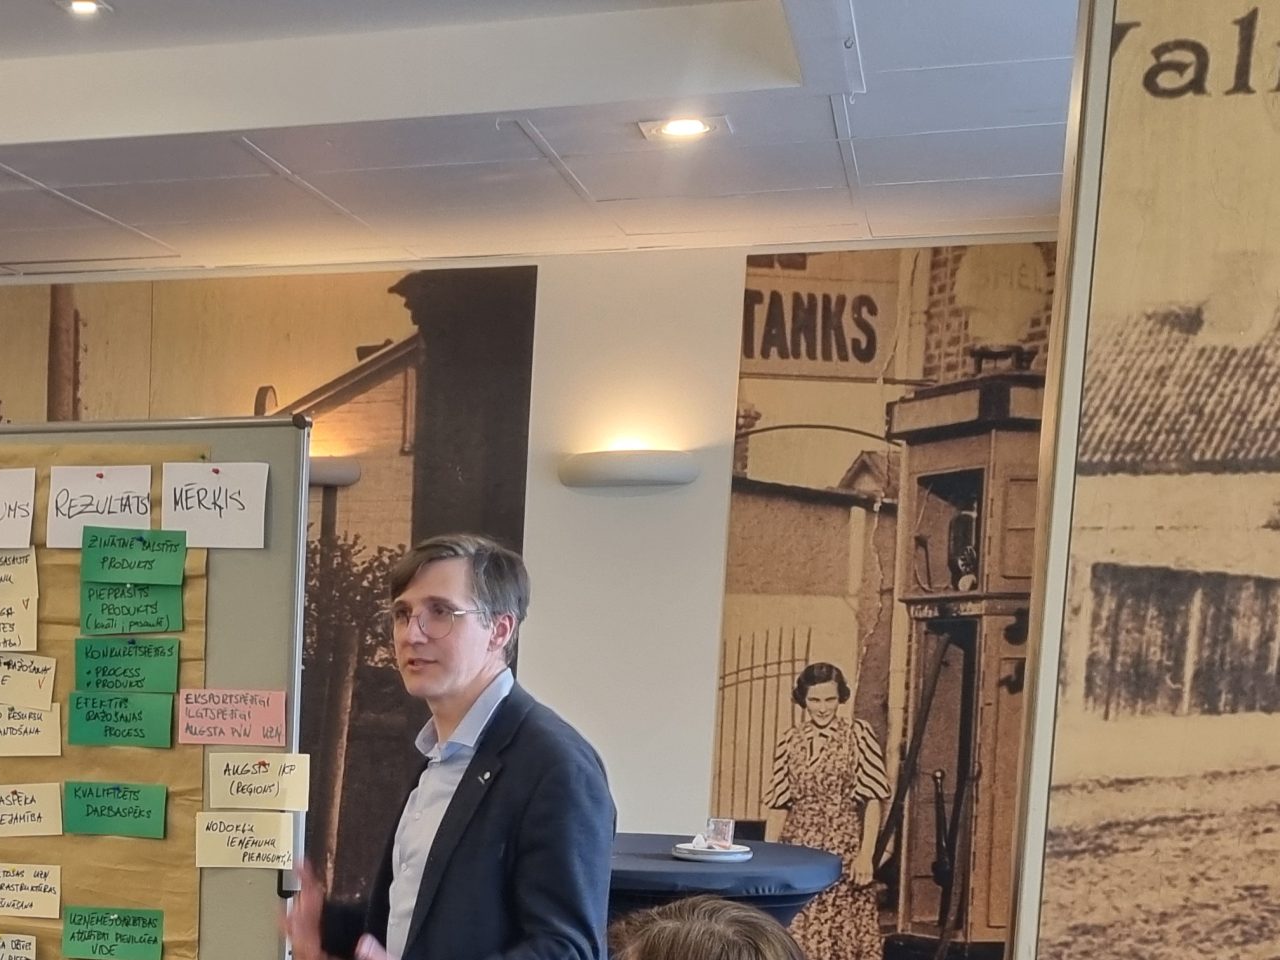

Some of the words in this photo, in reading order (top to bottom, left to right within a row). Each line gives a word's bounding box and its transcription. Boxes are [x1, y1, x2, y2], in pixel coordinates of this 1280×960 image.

[742, 287, 878, 363] TANKS
[55, 488, 150, 519] REZULTĀTS
[173, 483, 246, 518] MĒRĶIS
[101, 556, 155, 570] PRODUKTS
[101, 601, 158, 616] PRODUKTS
[95, 666, 141, 678] PROCESS
[96, 677, 145, 688] PRODUKTS
[104, 725, 145, 738] PROCESS
[185, 722, 225, 737] AUGSTA
[224, 762, 270, 776] AUGSTS
[86, 804, 152, 819] DARBASPĒKS
[91, 944, 118, 956] VIDE
